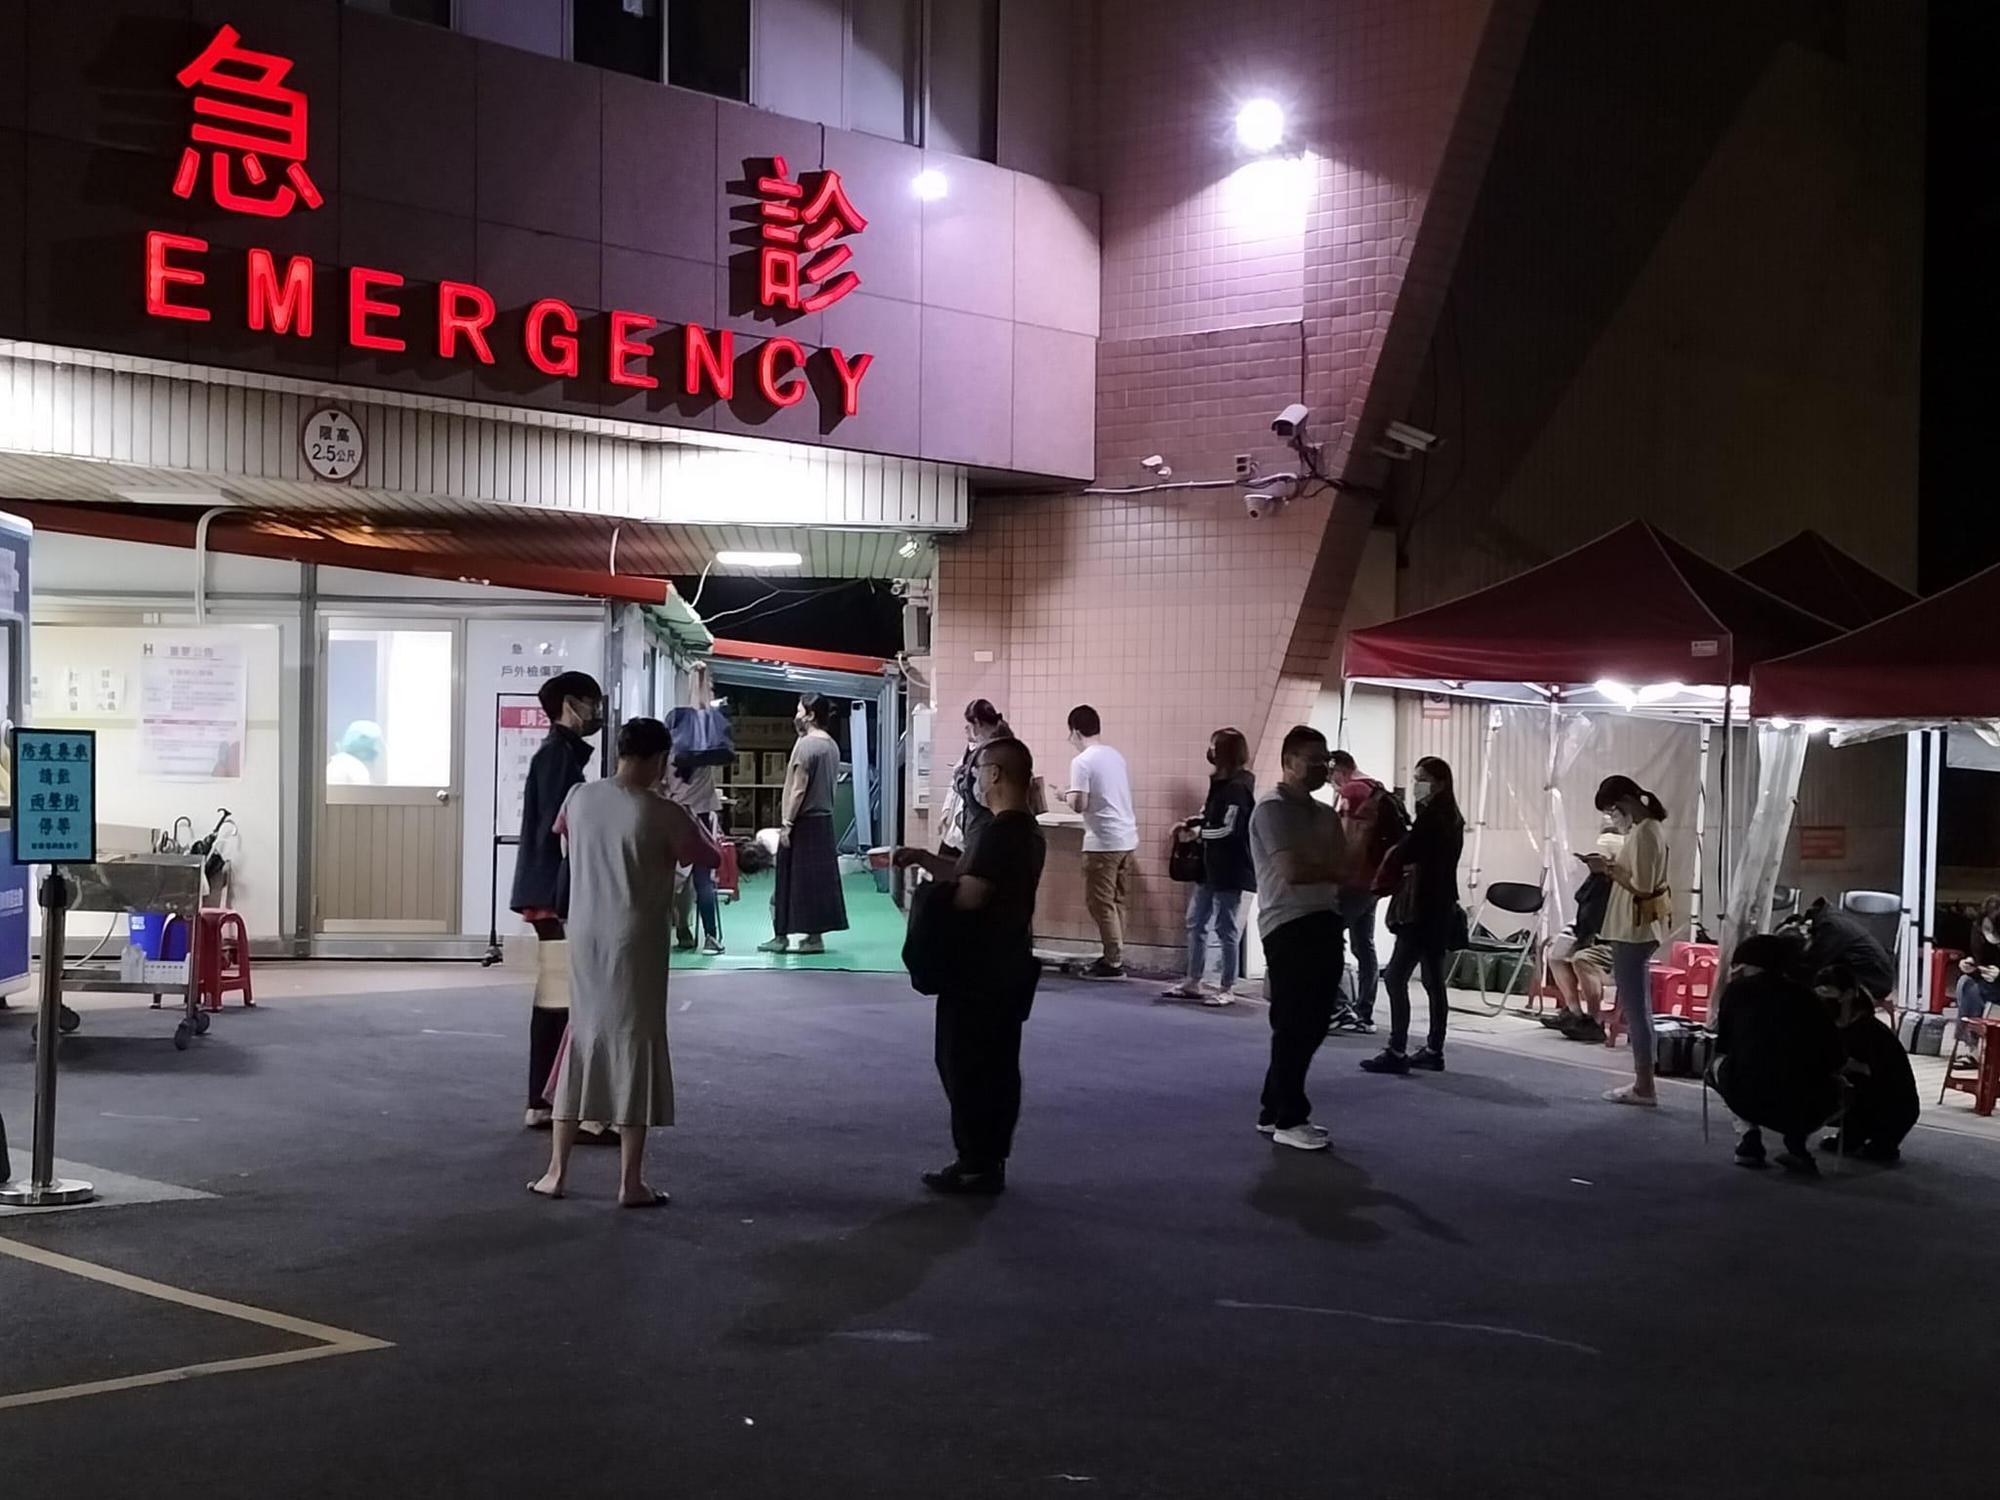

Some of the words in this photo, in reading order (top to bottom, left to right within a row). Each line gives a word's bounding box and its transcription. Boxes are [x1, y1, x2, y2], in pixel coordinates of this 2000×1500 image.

[174, 24, 325, 218] 急
[757, 155, 868, 315] 診
[145, 229, 874, 418] EMERGENCY
[319, 425, 350, 443] 限高
